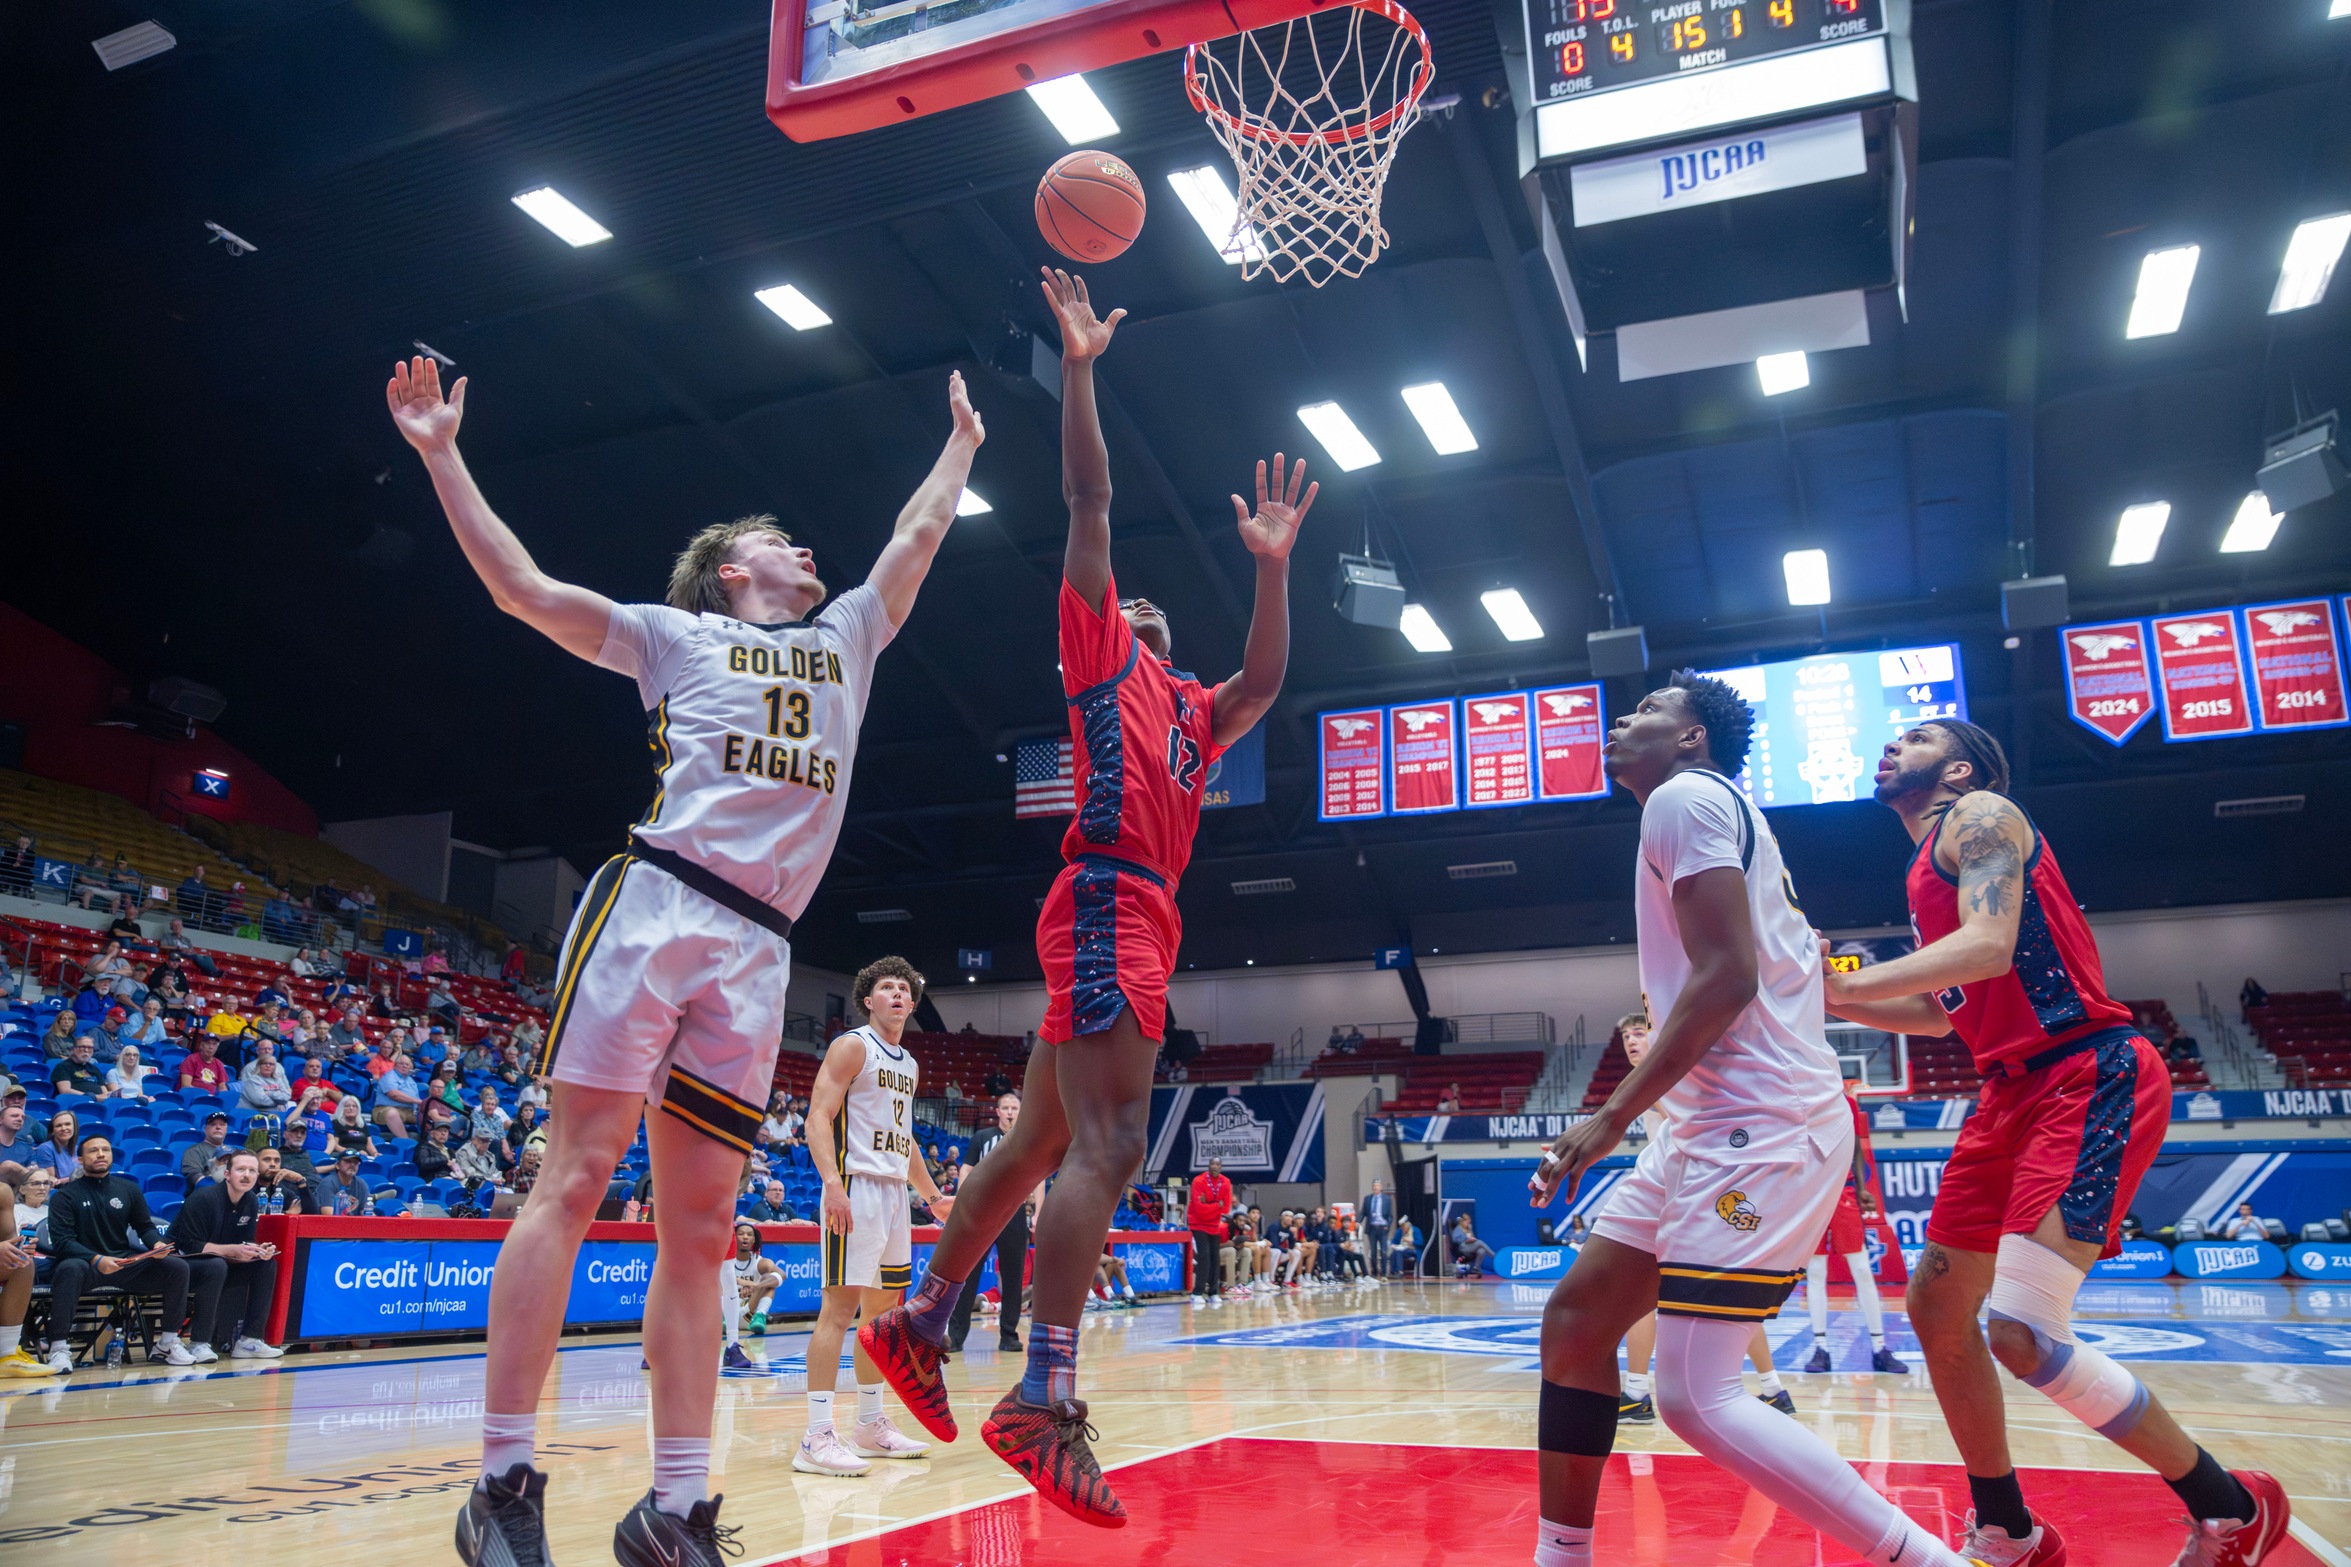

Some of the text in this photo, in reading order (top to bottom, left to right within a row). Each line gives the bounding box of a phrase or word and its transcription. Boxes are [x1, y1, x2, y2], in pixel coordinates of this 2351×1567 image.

[1652, 1, 1702, 23] PLAYER
[1770, 0, 1794, 27] 4
[1544, 16, 1639, 47] FOULS T.O.L.
[1563, 9, 1743, 75] 0 4 15 1
[1550, 17, 1868, 97] SCORE SCORE
[1679, 47, 1726, 70] MATCH
[1661, 140, 1766, 199] NJCAA
[728, 645, 844, 687] GOLDEN
[1906, 685, 1932, 703] 14
[2276, 689, 2326, 709] 2014
[763, 685, 812, 741] 13
[2088, 698, 2139, 717] 2024
[2182, 698, 2232, 719] 2015
[723, 733, 837, 796] EAGLES
[1167, 724, 1202, 796] 12
[1545, 749, 1569, 760] 2024
[1398, 761, 1449, 774] 2015 2017
[203, 778, 220, 795] X
[42, 862, 66, 884] K
[397, 936, 410, 951] J
[967, 953, 983, 966] H
[1385, 950, 1400, 966] F
[878, 1068, 914, 1097] GOLDEN
[893, 1098, 904, 1128] 12
[2264, 1091, 2332, 1116] NJCAA
[1213, 1114, 1250, 1135] NJCAA
[1489, 1116, 1539, 1138] NJCAA
[1546, 1116, 1562, 1137] DI
[873, 1130, 910, 1158] EAGLES
[1201, 1144, 1262, 1157] CHAMPIONSHIP
[1883, 1161, 1947, 1198] HUT
[1728, 1212, 1762, 1231] CSI
[587, 1258, 648, 1284] Credit
[776, 1257, 821, 1280] Credit
[1511, 1251, 1561, 1276] NJCAA
[2194, 1246, 2260, 1275] NJCAA
[335, 1259, 418, 1290] Credit
[379, 1298, 466, 1316] cu1.com/njcaa
